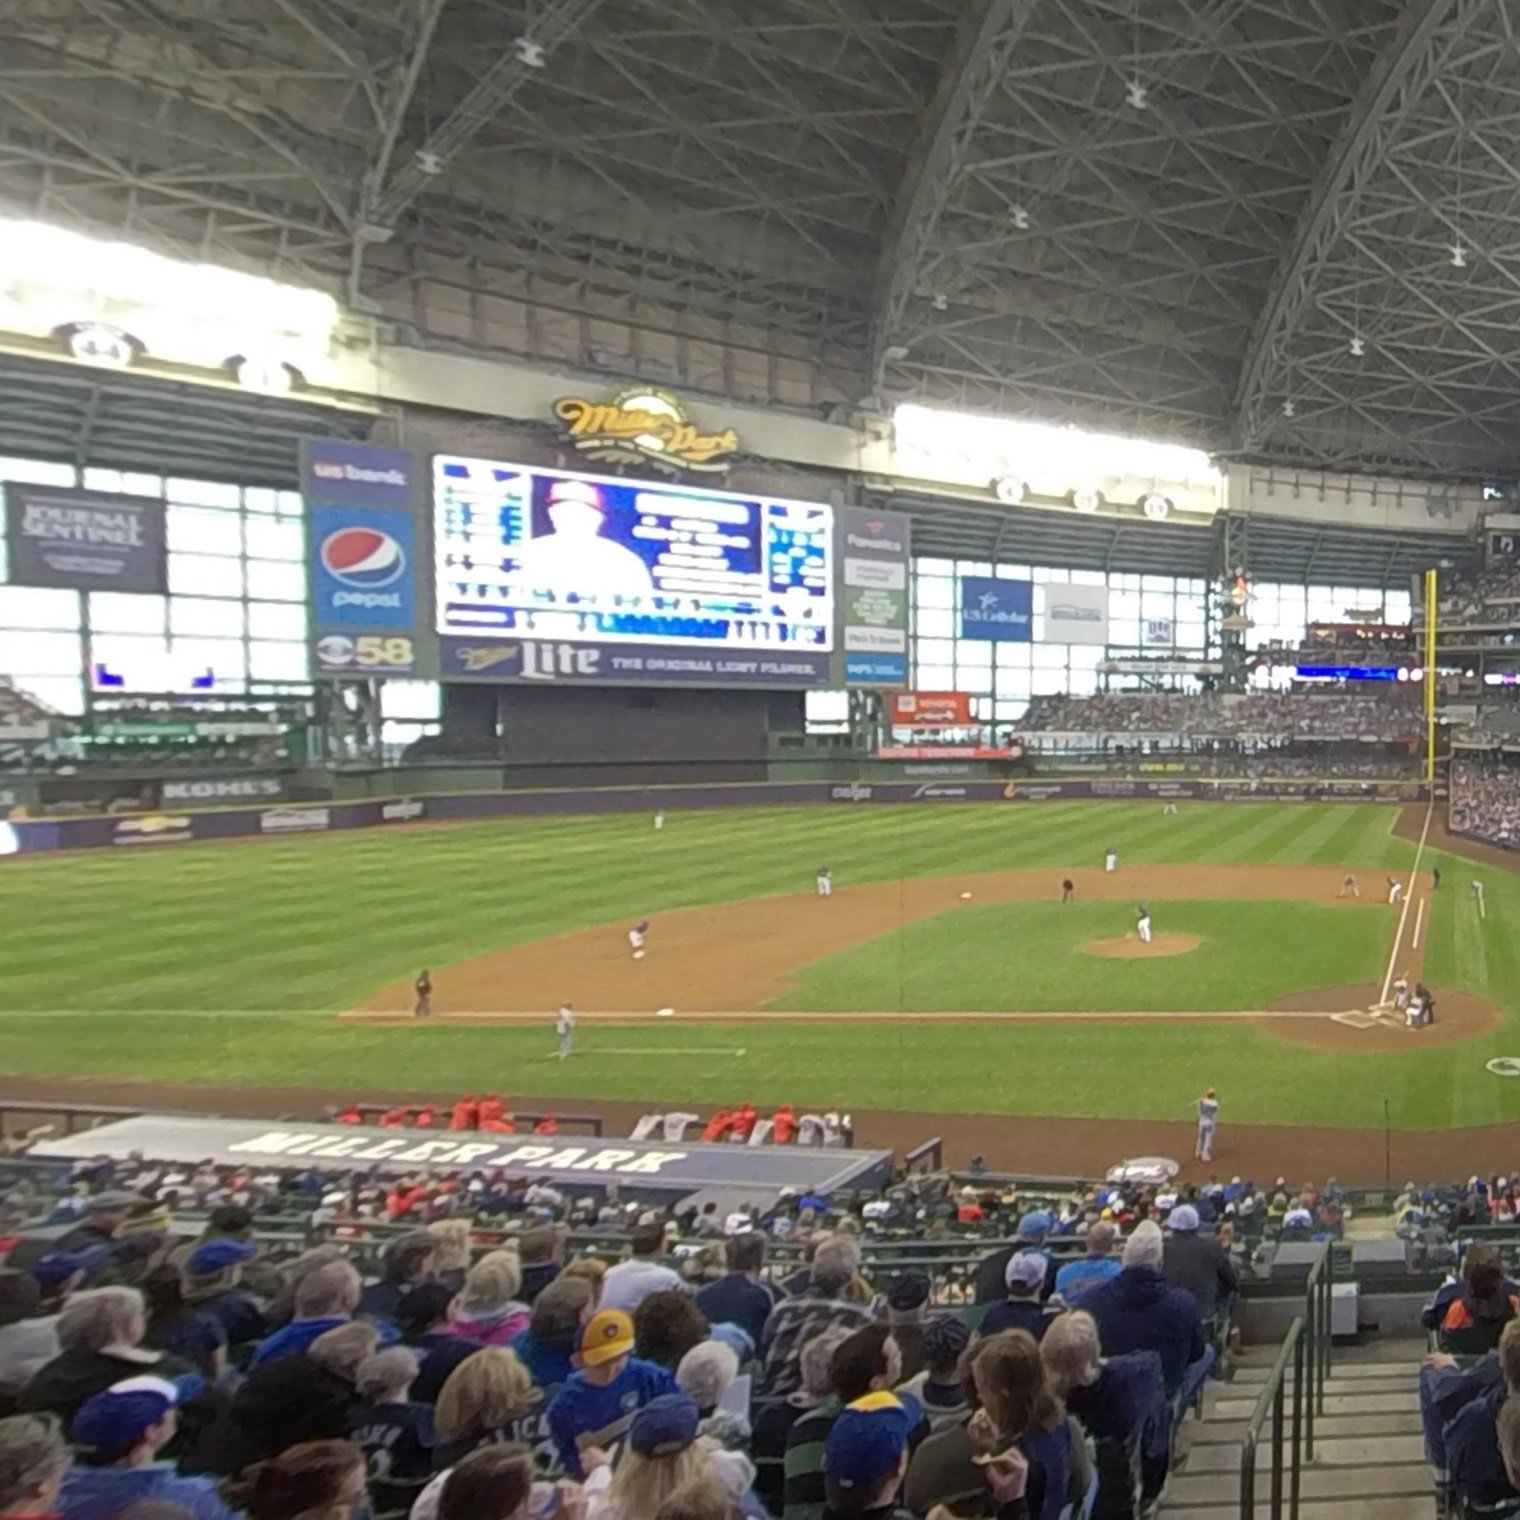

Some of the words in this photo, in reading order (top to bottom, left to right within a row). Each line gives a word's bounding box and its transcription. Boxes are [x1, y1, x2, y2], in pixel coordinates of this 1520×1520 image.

[661, 421, 738, 461] Park
[21, 519, 144, 546] SENTINEL
[23, 504, 142, 533] JOURNAL
[332, 590, 402, 608] pepsi
[356, 637, 414, 664] 58
[519, 641, 600, 680] Lite
[229, 1132, 498, 1165] MILLER
[487, 1146, 688, 1174] PARK
